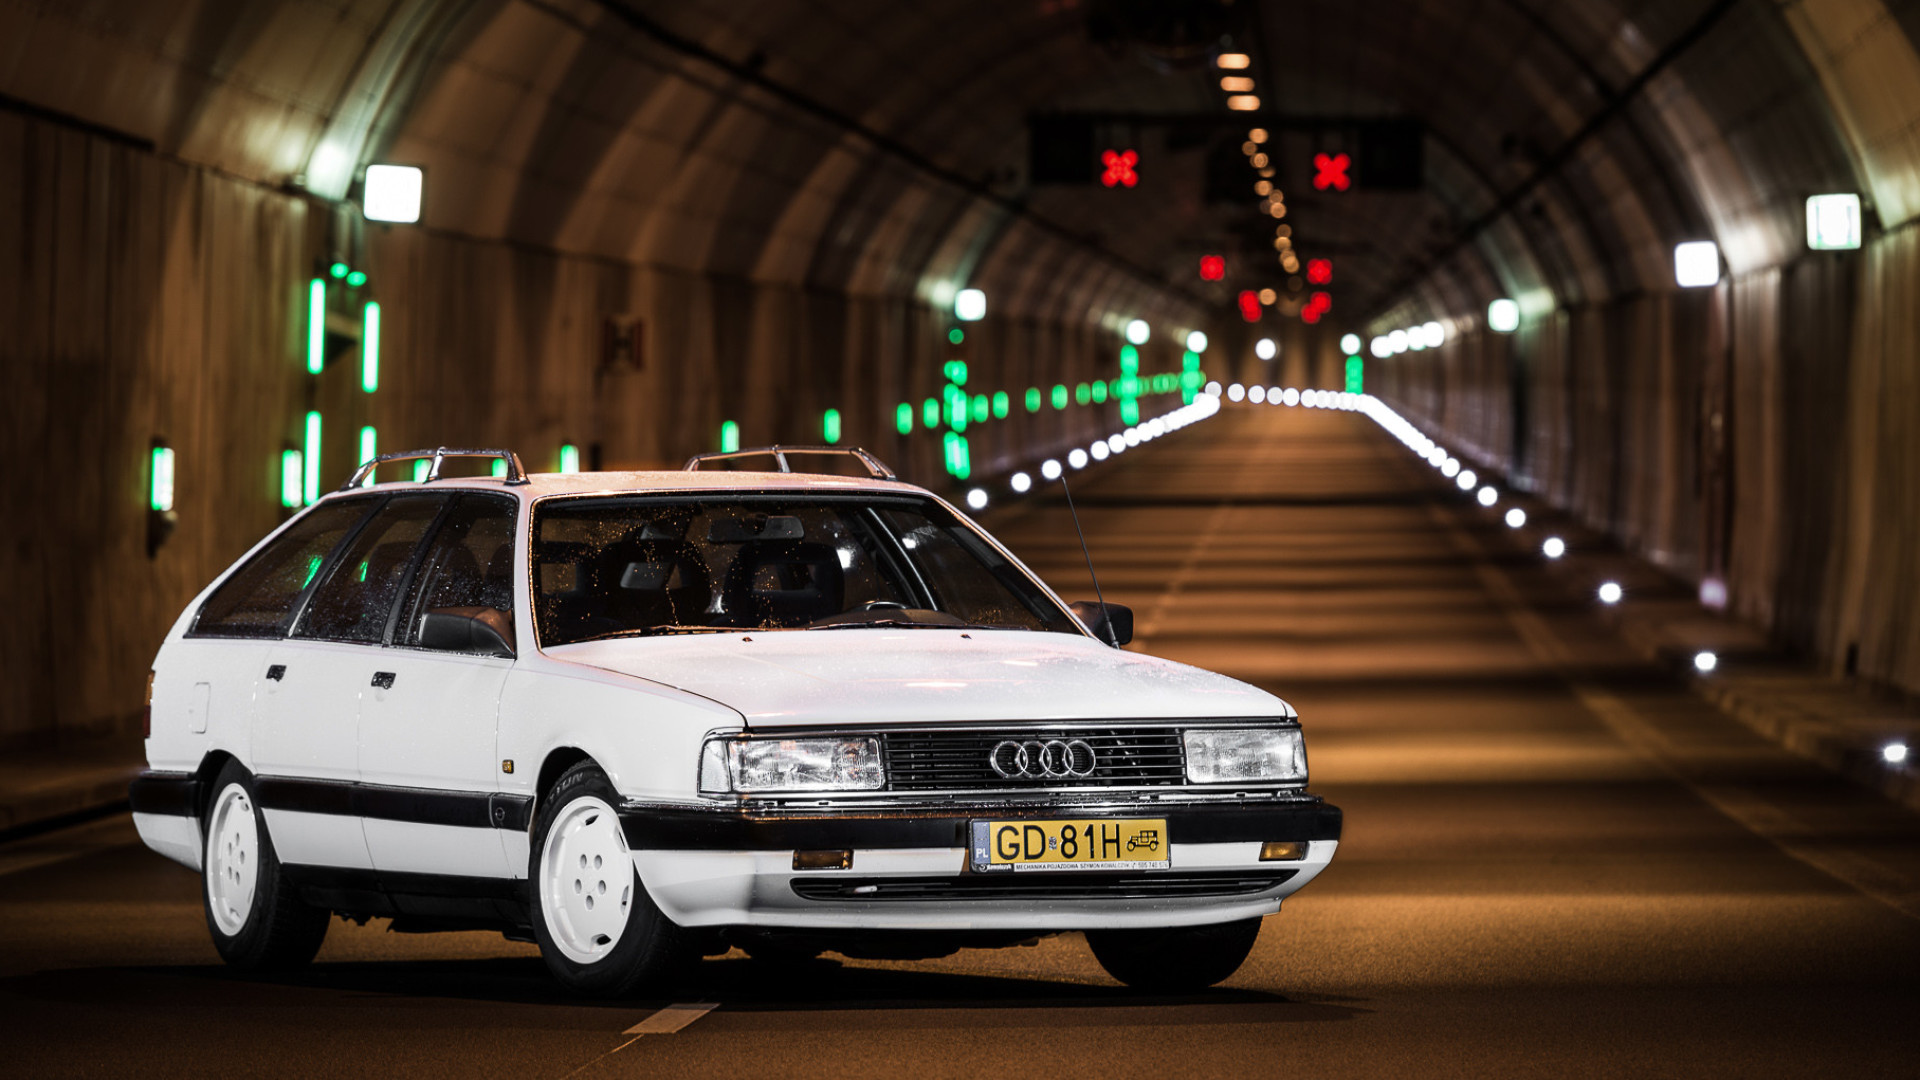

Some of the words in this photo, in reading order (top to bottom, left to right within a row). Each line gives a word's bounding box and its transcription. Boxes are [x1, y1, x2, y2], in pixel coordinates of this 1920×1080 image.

[976, 848, 989, 858] PL
[997, 825, 1046, 860] GD
[1060, 823, 1121, 860] 81H
